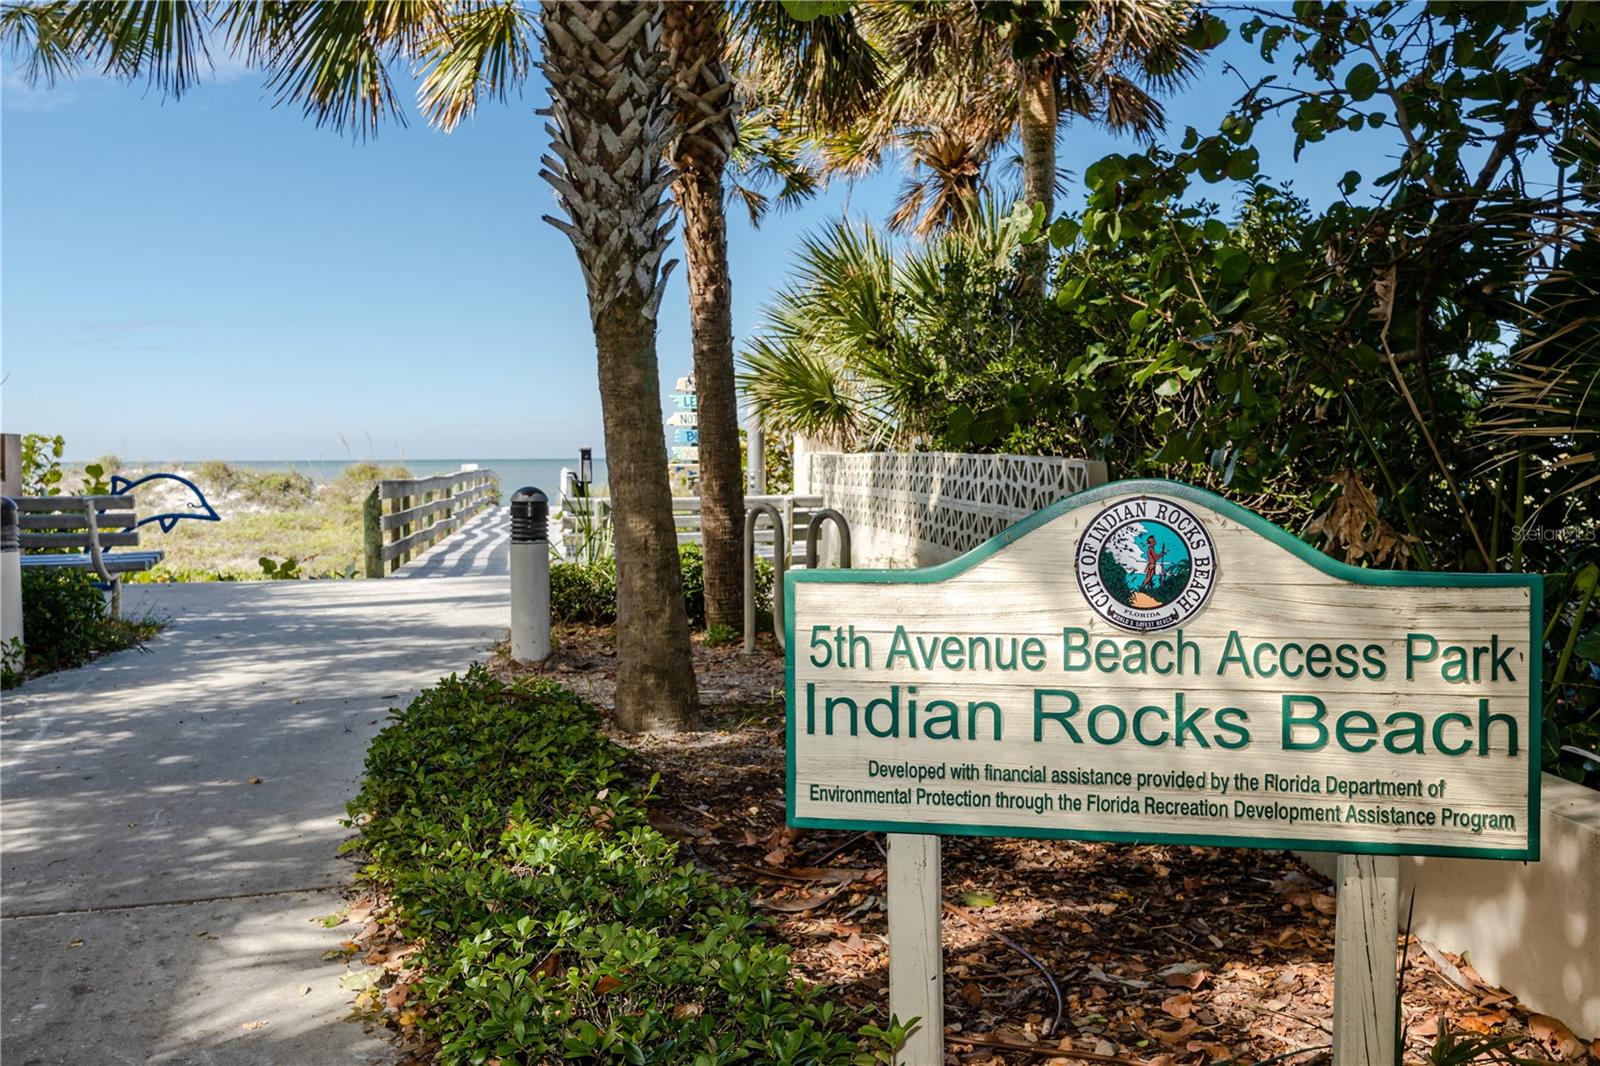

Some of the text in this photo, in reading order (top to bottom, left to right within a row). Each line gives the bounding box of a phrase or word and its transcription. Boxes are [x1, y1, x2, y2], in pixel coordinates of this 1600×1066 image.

[680, 414, 697, 425] NOT
[684, 396, 698, 408] LE
[1081, 502, 1211, 614] CITY OF INDIAN ROCKS BEACH
[1124, 609, 1161, 618] FLORIDA
[809, 625, 1516, 683] 5th Avenue Beach Access Park
[806, 682, 1518, 757] Indian Rocks Beach
[868, 760, 1447, 799] Developed with financial assistance provided by the Florida Department of
[809, 784, 1516, 832] Environmental Protection through the Florida Recreation Development Assistance Program
